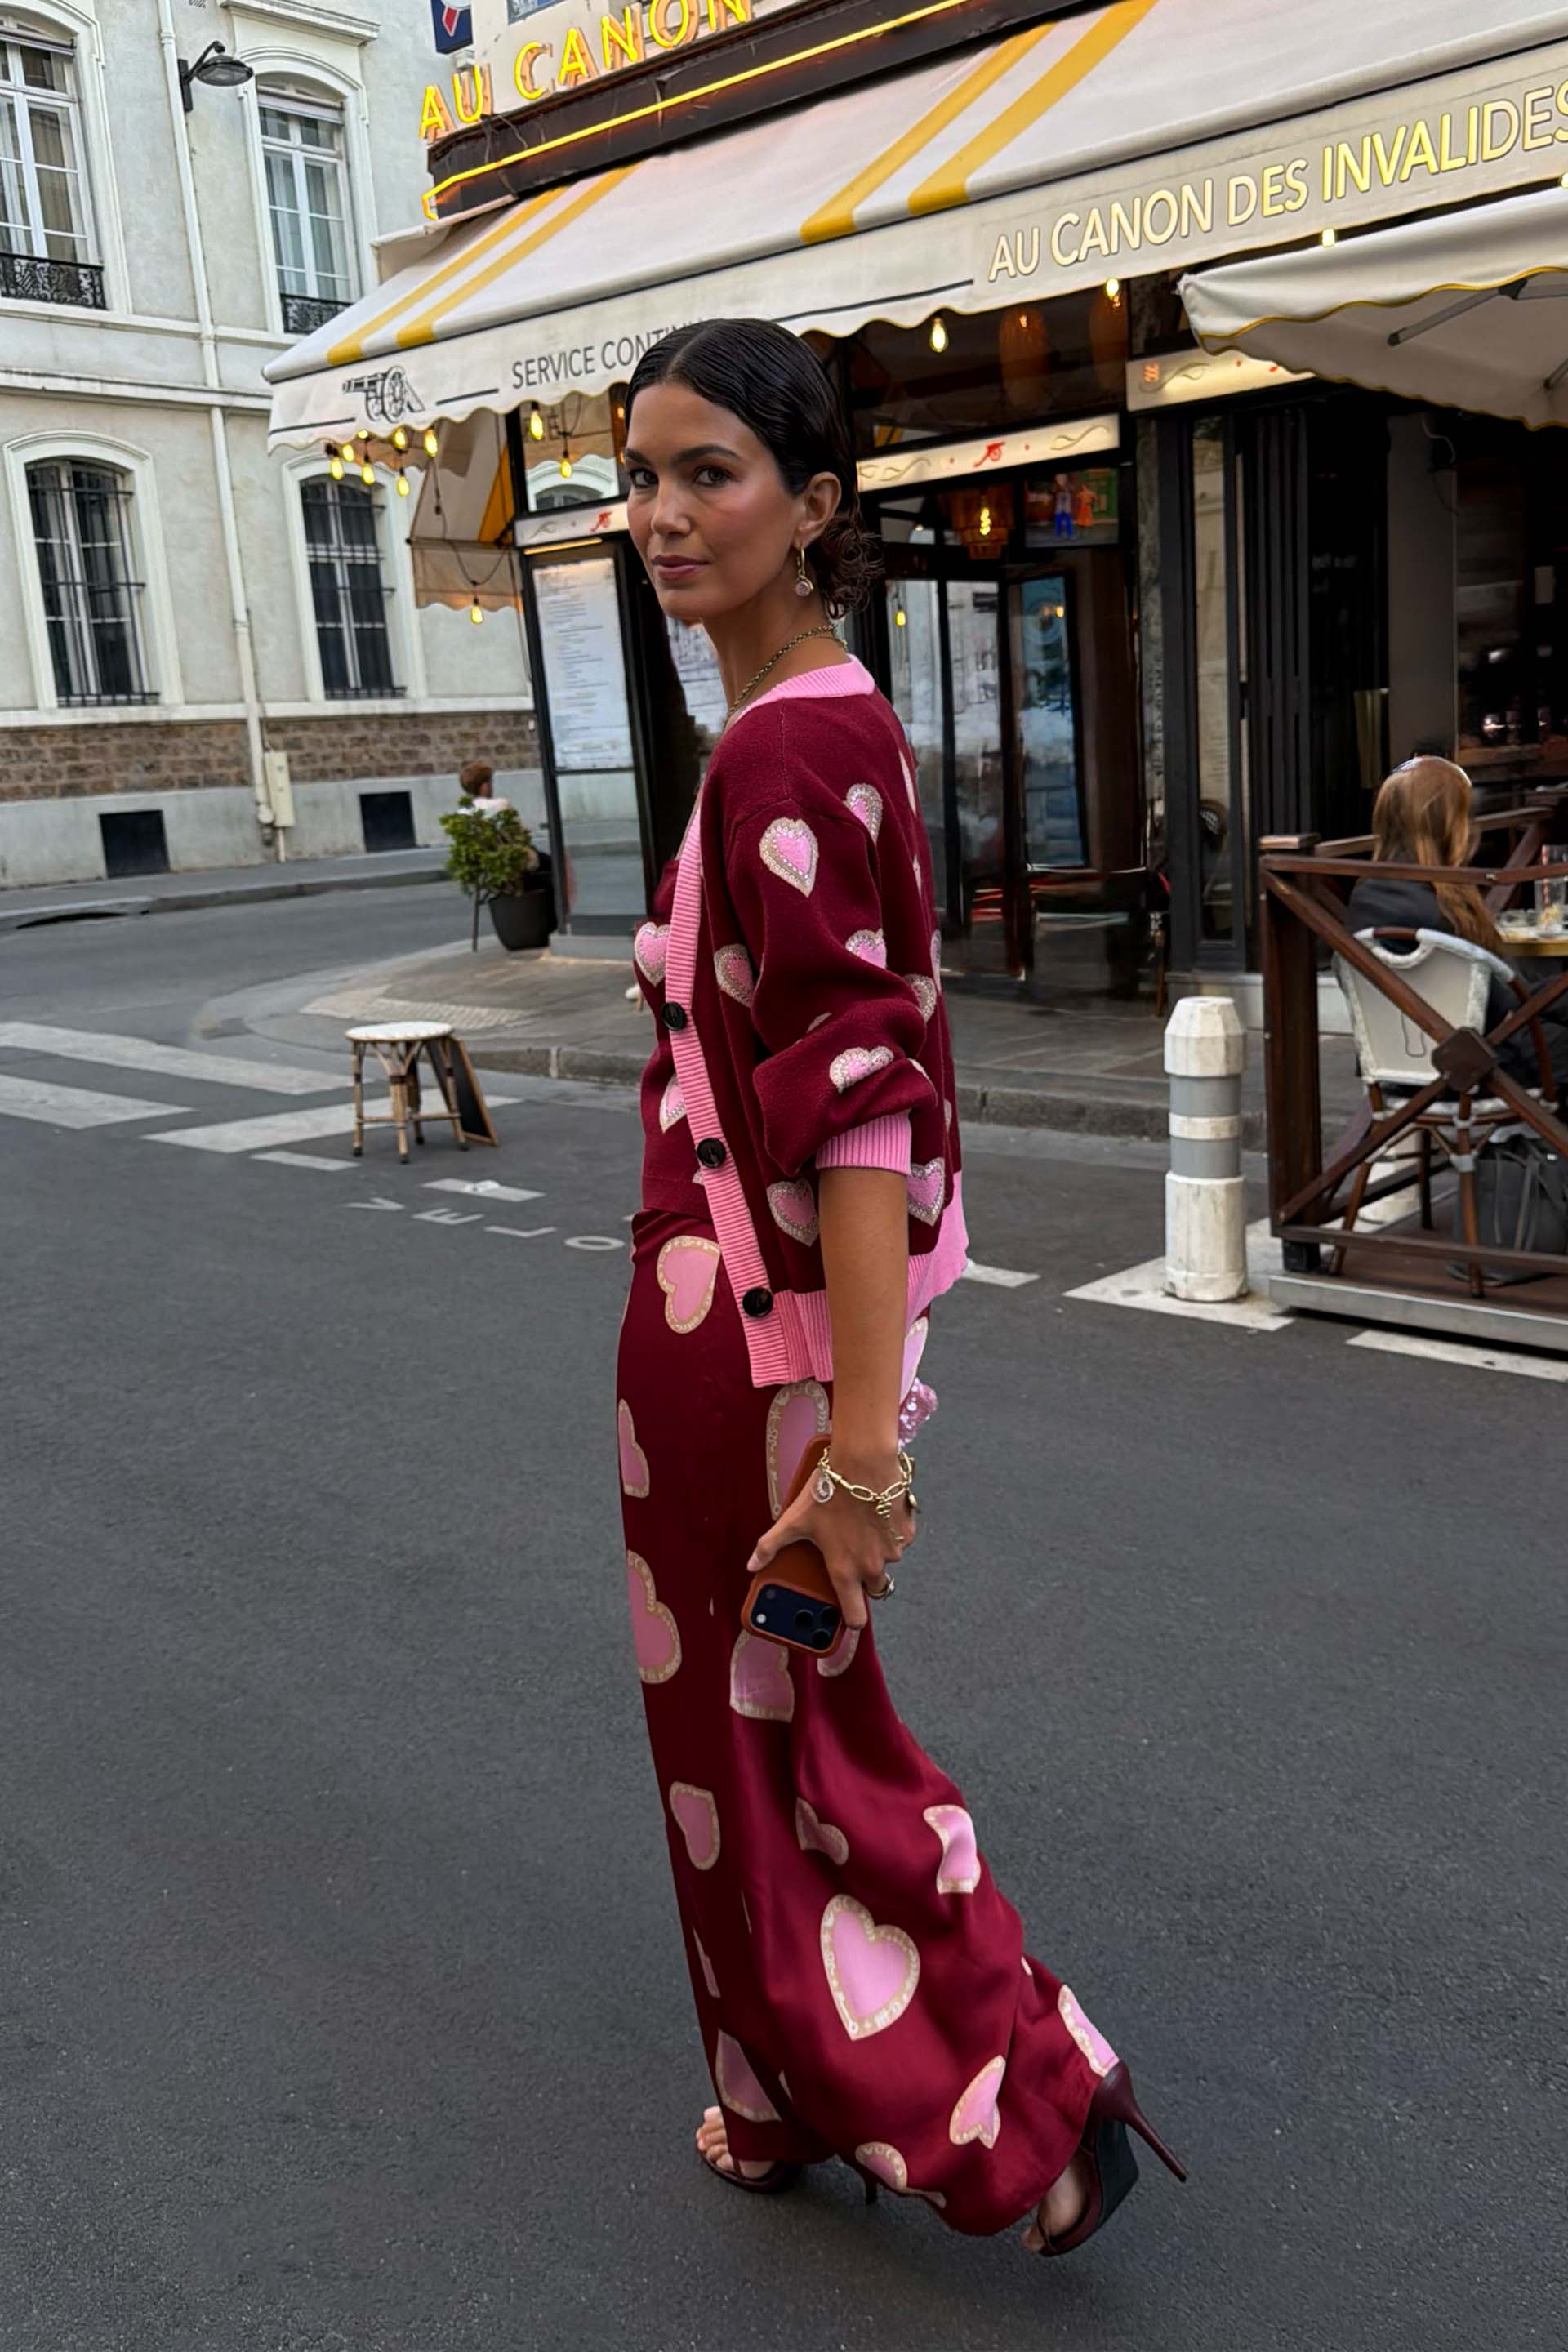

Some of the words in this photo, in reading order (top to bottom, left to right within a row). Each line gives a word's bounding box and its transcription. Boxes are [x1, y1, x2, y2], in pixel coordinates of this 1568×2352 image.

[419, 65, 493, 143] AU
[514, 0, 752, 101] CANON
[988, 227, 1040, 282] AU
[1050, 178, 1213, 266] CANON
[1227, 158, 1308, 226] DES
[512, 346, 595, 389] SERVICE
[346, 1196, 626, 1251] VELO
